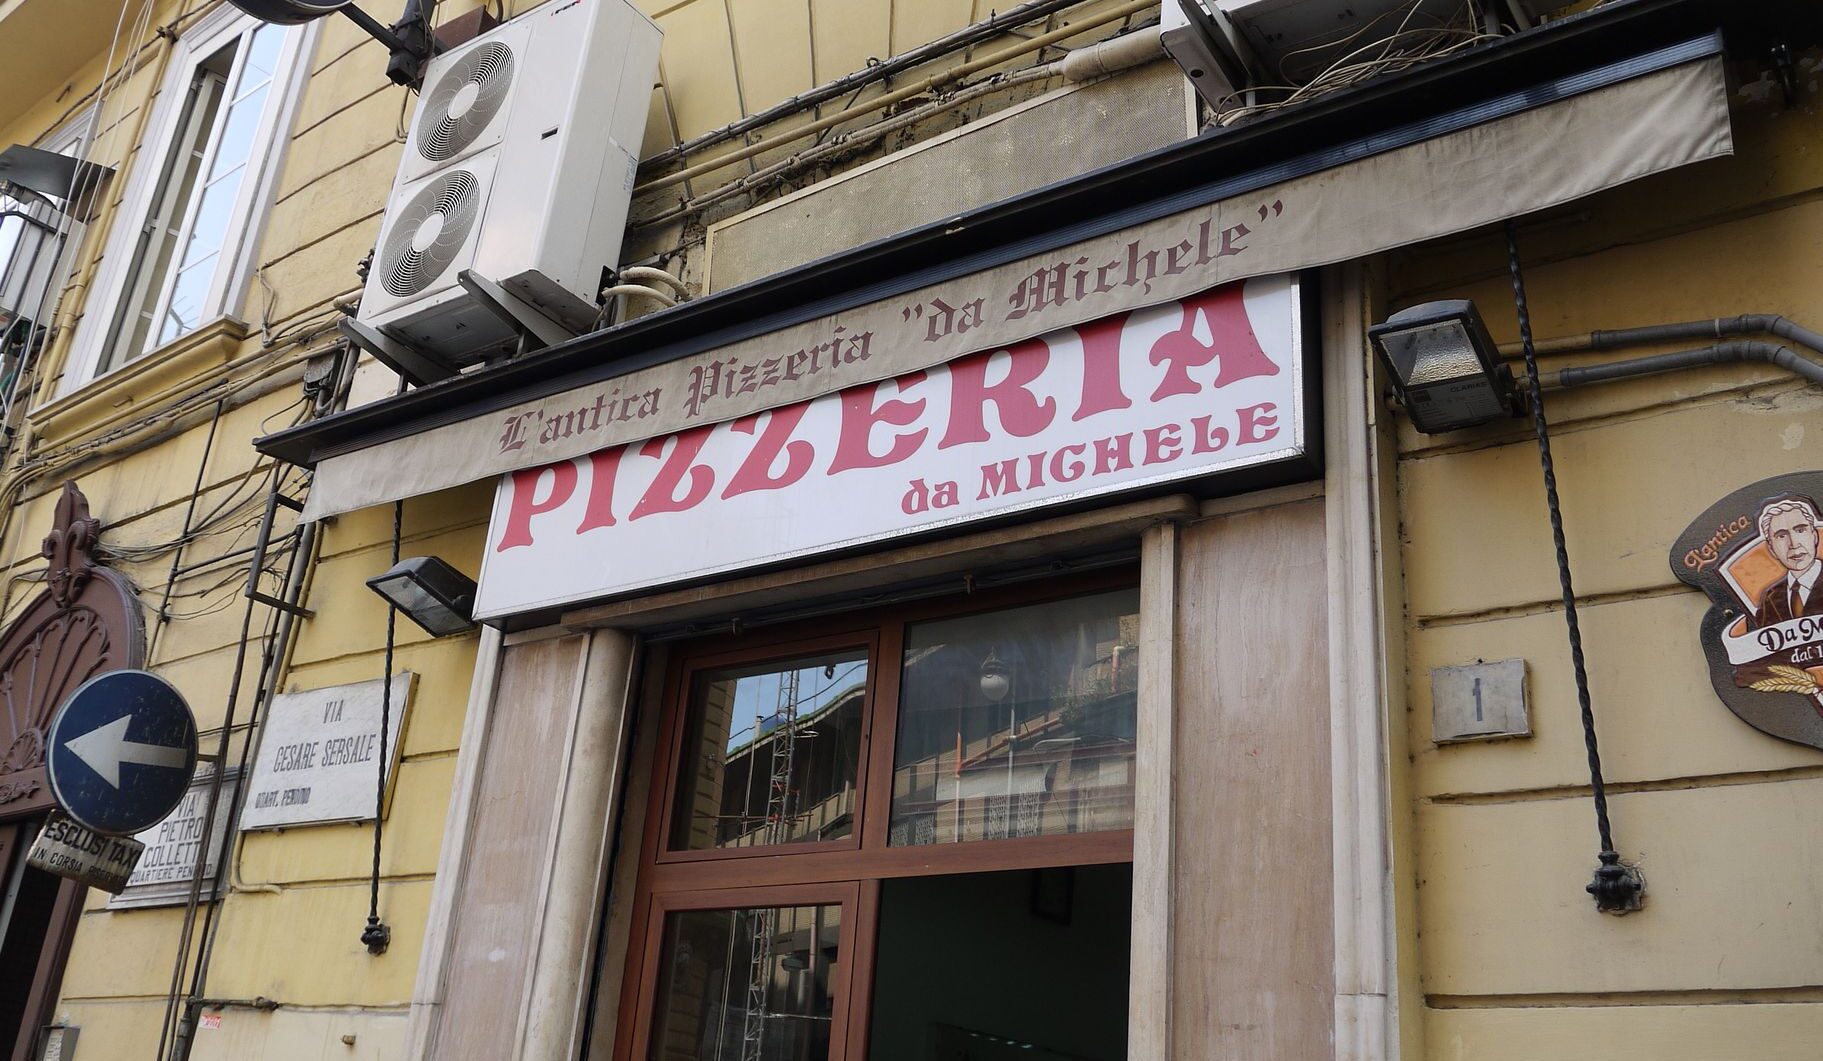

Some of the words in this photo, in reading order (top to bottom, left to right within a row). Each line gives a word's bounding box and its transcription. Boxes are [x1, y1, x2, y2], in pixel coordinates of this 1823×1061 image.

[499, 387, 662, 455] L'antica
[682, 325, 874, 420] Pizzeria
[496, 278, 1281, 553] PIZZERIA
[901, 477, 960, 516] da
[975, 402, 1281, 501] MICHELE
[1757, 627, 1798, 652] Da
[1791, 646, 1813, 663] dal
[323, 700, 344, 724] VIA
[1472, 677, 1483, 722] 1
[273, 741, 319, 773] CESARE
[321, 733, 376, 767] SERSALE
[178, 794, 196, 818] VIA
[157, 816, 205, 844] PIETRO
[33, 846, 47, 860] IN
[49, 851, 83, 873] CORSIA
